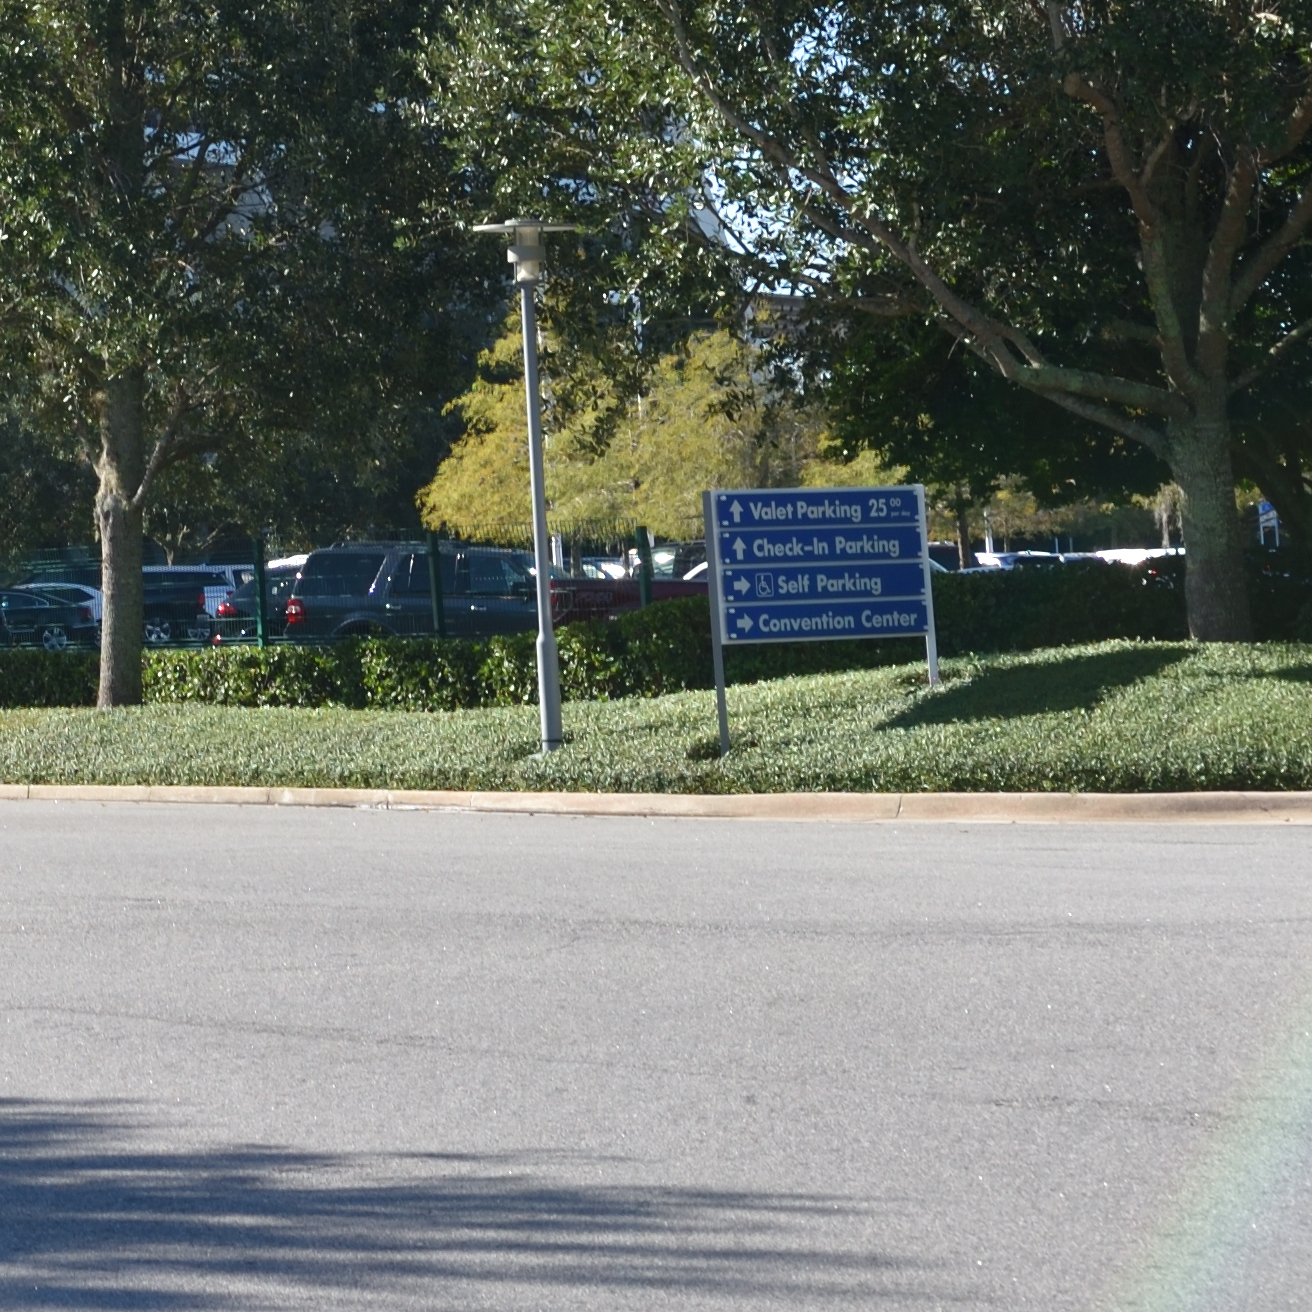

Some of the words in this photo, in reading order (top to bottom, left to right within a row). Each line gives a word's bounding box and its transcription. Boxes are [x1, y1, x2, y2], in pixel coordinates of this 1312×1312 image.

[749, 501, 794, 520] Valet
[796, 499, 862, 523] Parking
[869, 498, 887, 518] 25
[753, 537, 829, 557] Check-In
[835, 535, 900, 558] Parking
[777, 574, 810, 594] Self
[816, 572, 882, 595] Parking
[758, 611, 855, 633] Convention
[861, 609, 918, 628] Center
